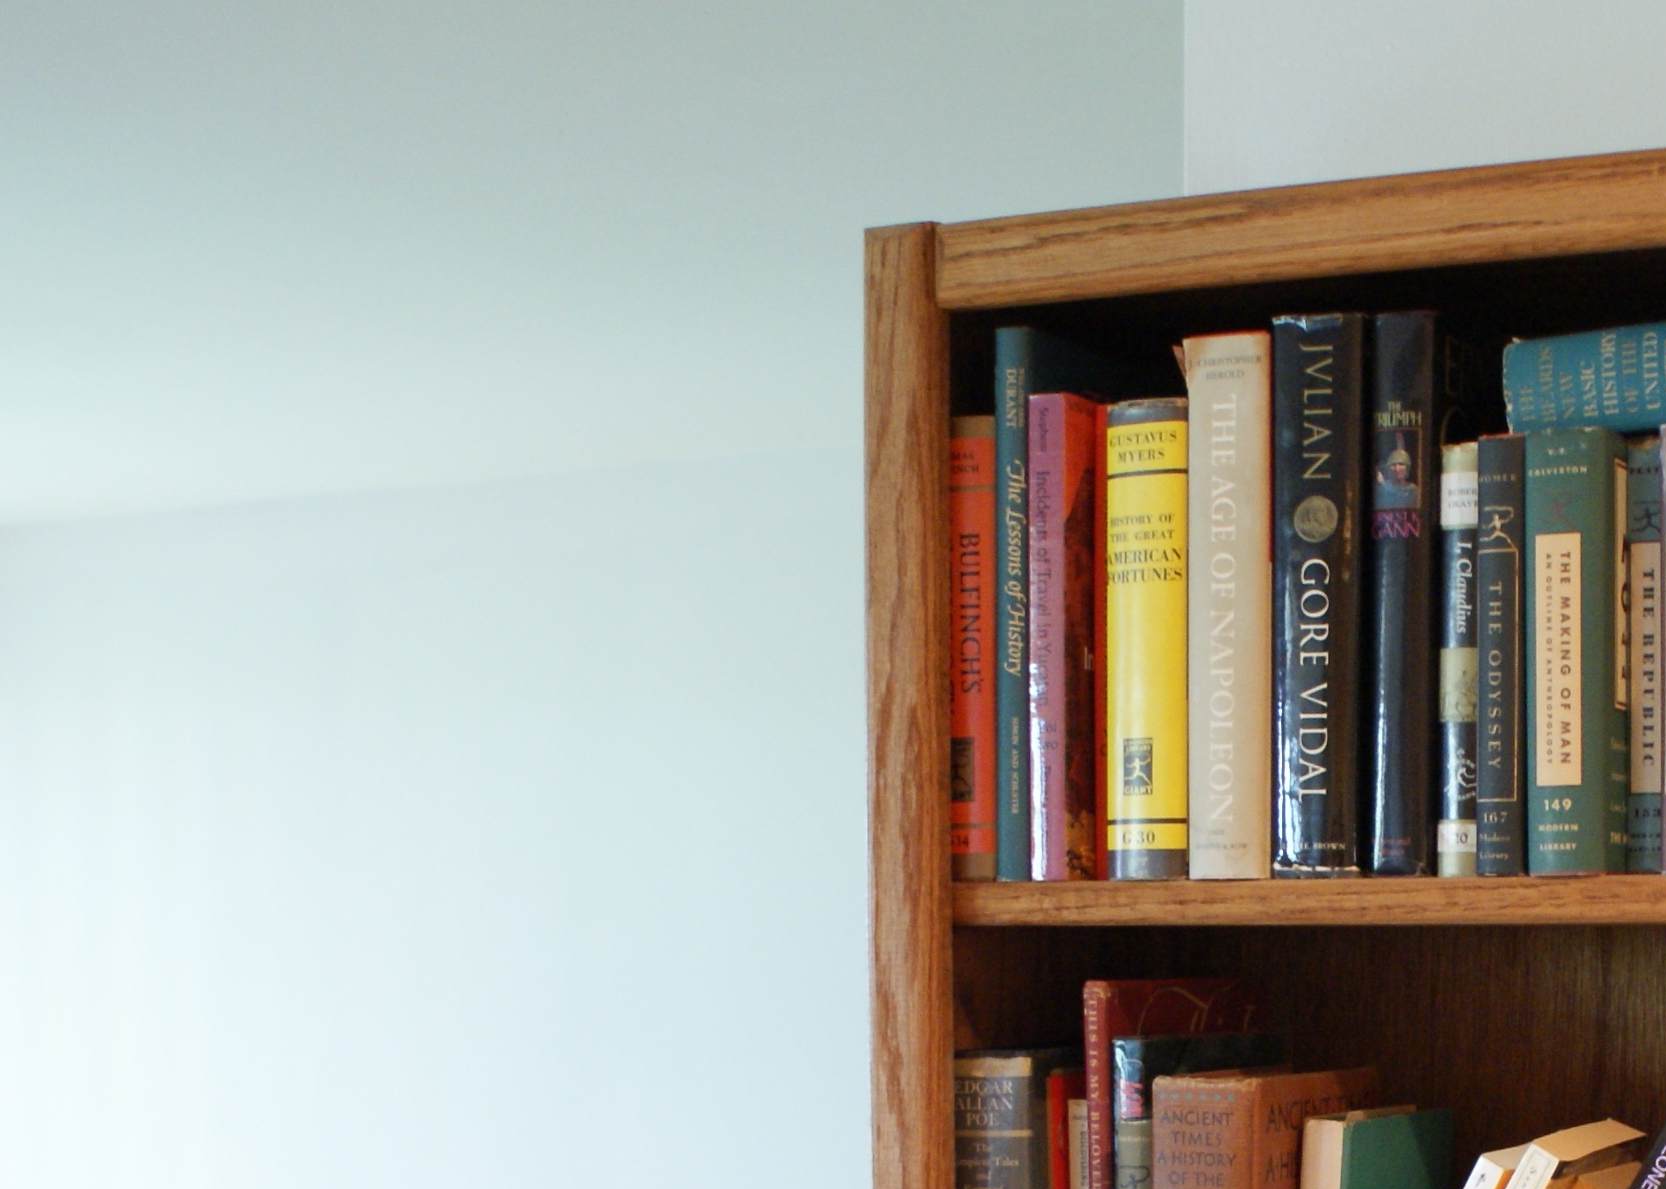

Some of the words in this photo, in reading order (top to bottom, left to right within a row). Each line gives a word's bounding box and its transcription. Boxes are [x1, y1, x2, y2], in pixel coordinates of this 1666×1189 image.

[1579, 360, 1598, 417] BASIC
[1601, 333, 1619, 415] HISTORY
[1643, 332, 1660, 410] UNITED
[1005, 368, 1017, 428] DURANT
[1110, 431, 1177, 446] GUSTAVUS
[1211, 394, 1237, 467] THE
[1117, 450, 1165, 463] MYERS
[1006, 458, 1027, 503] The
[1109, 515, 1153, 528] HISTORY
[1159, 514, 1174, 526] OF
[1210, 476, 1237, 543] AGE
[1005, 504, 1026, 577] Lessons
[1108, 548, 1182, 566] AMERICAN
[1135, 530, 1175, 542] GREAT
[1210, 553, 1237, 599] OF
[1560, 551, 1572, 584] THE
[1004, 580, 1024, 603] of
[1301, 559, 1331, 666] GORE
[1456, 558, 1473, 635] Claudius
[1488, 581, 1503, 635] THE
[1641, 568, 1655, 618] THE
[1003, 602, 1027, 676] History
[1560, 596, 1572, 676] MAKING
[1209, 610, 1236, 823] NAPOLEON
[1487, 649, 1503, 770] ODYSSEY
[1560, 687, 1572, 711] OF
[1299, 682, 1329, 803] VIDAL
[1560, 720, 1572, 764] MAN
[1543, 799, 1573, 812] 149
[1090, 1074, 1102, 1102] MY
[965, 1112, 998, 1128] POE
[1160, 1110, 1234, 1127] ANCIENT
[1170, 1130, 1222, 1147] TIMES
[1167, 1171, 1188, 1186] OF
[1194, 1171, 1225, 1188] THE
[1172, 1151, 1237, 1167] HISTORY
